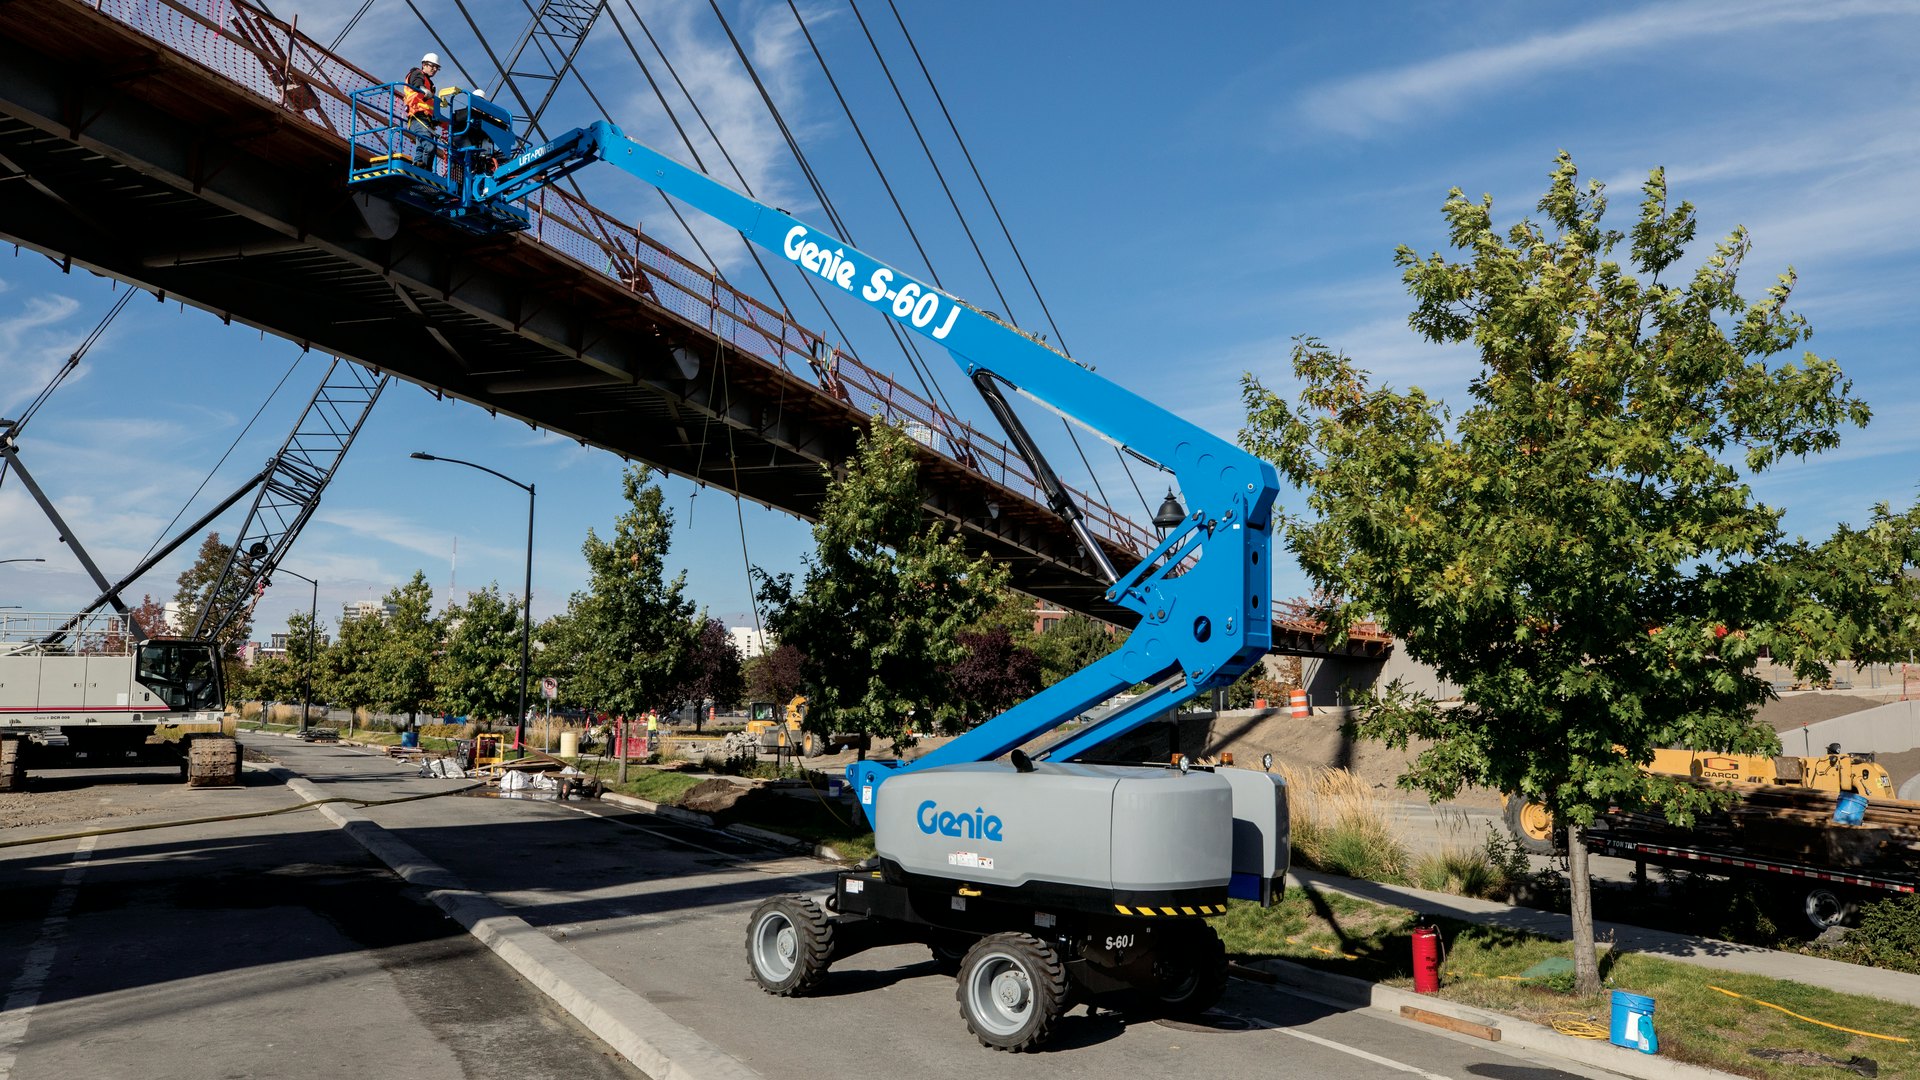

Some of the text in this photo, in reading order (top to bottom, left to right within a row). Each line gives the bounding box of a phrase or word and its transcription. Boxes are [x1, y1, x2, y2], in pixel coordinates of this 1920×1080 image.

[519, 152, 531, 167] LIFT
[784, 225, 962, 339] Genie S-60 J
[1704, 771, 1739, 779] GARCO
[917, 800, 1003, 842] Genie
[1612, 840, 1624, 848] TON
[1105, 934, 1134, 950] S-60 J
